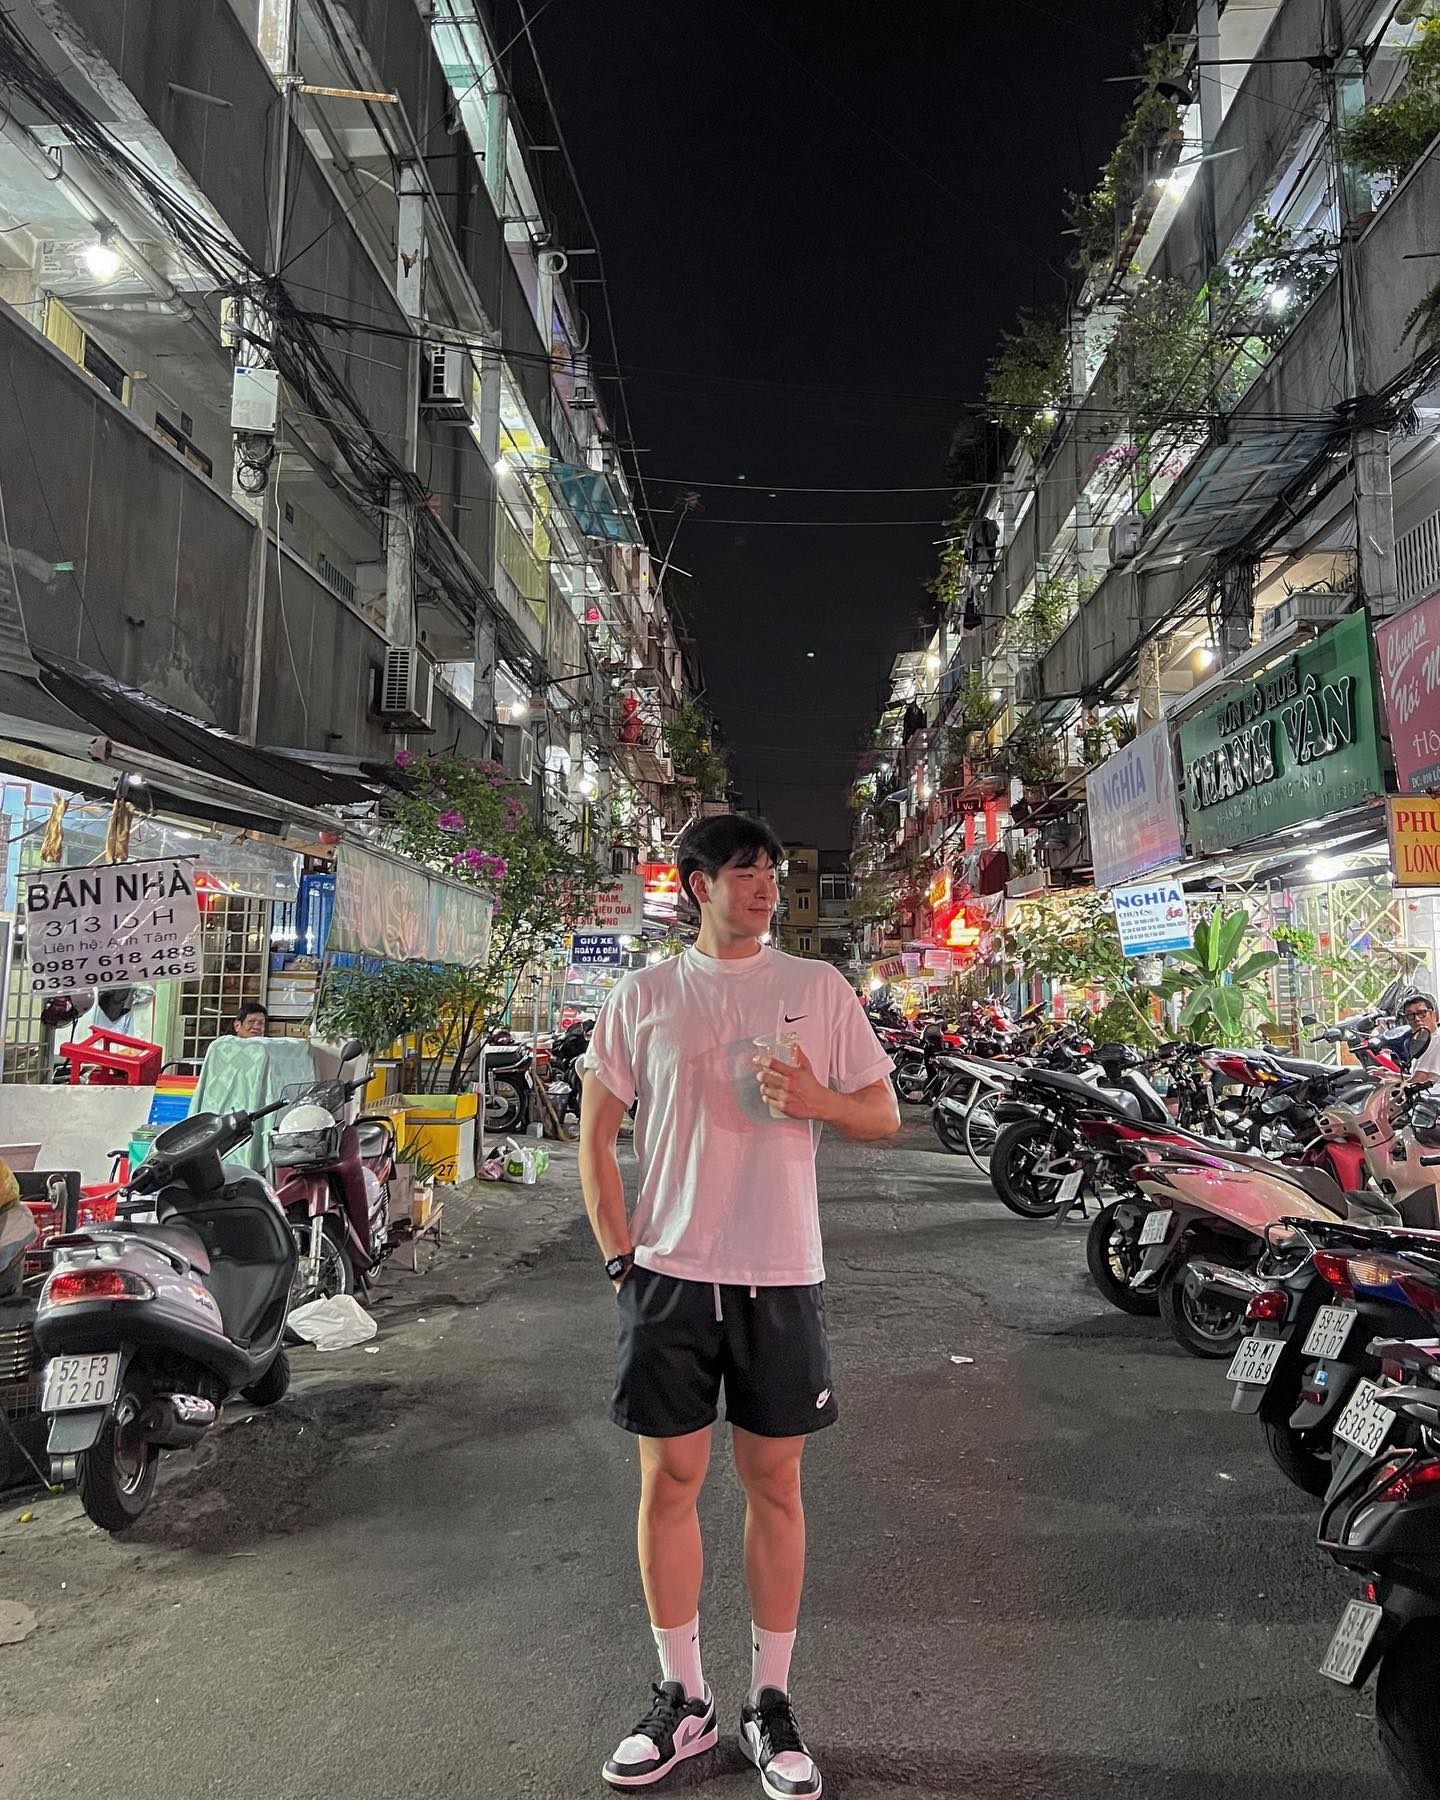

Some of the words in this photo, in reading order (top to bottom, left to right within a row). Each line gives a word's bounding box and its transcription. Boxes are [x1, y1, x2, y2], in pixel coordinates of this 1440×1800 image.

[1387, 614, 1428, 697] Chuyên
[1264, 655, 1299, 711] HUẾ
[1188, 719, 1275, 813] THANH
[1280, 673, 1352, 766] VÂN
[1102, 751, 1146, 814] NGHĨA
[28, 874, 101, 912] BÁN
[116, 863, 192, 902] NHÀ
[1116, 888, 1180, 909] NGHĨA
[46, 916, 101, 936] 313
[153, 909, 173, 926] H
[44, 938, 74, 954] Liên
[80, 938, 103, 951] hệ:
[143, 931, 177, 943] Tâm
[580, 935, 598, 945] GIỮ
[600, 937, 613, 945] XE
[32, 958, 88, 974] 0987
[98, 952, 142, 967] 618
[151, 946, 196, 961] 488
[32, 976, 76, 990] 033
[85, 970, 129, 985] 902
[138, 962, 197, 979] 1465
[1308, 1331, 1343, 1359] 151.07
[59, 1356, 109, 1381] 52-F3
[57, 1380, 104, 1404] 1220
[1338, 1409, 1383, 1450] 638.38
